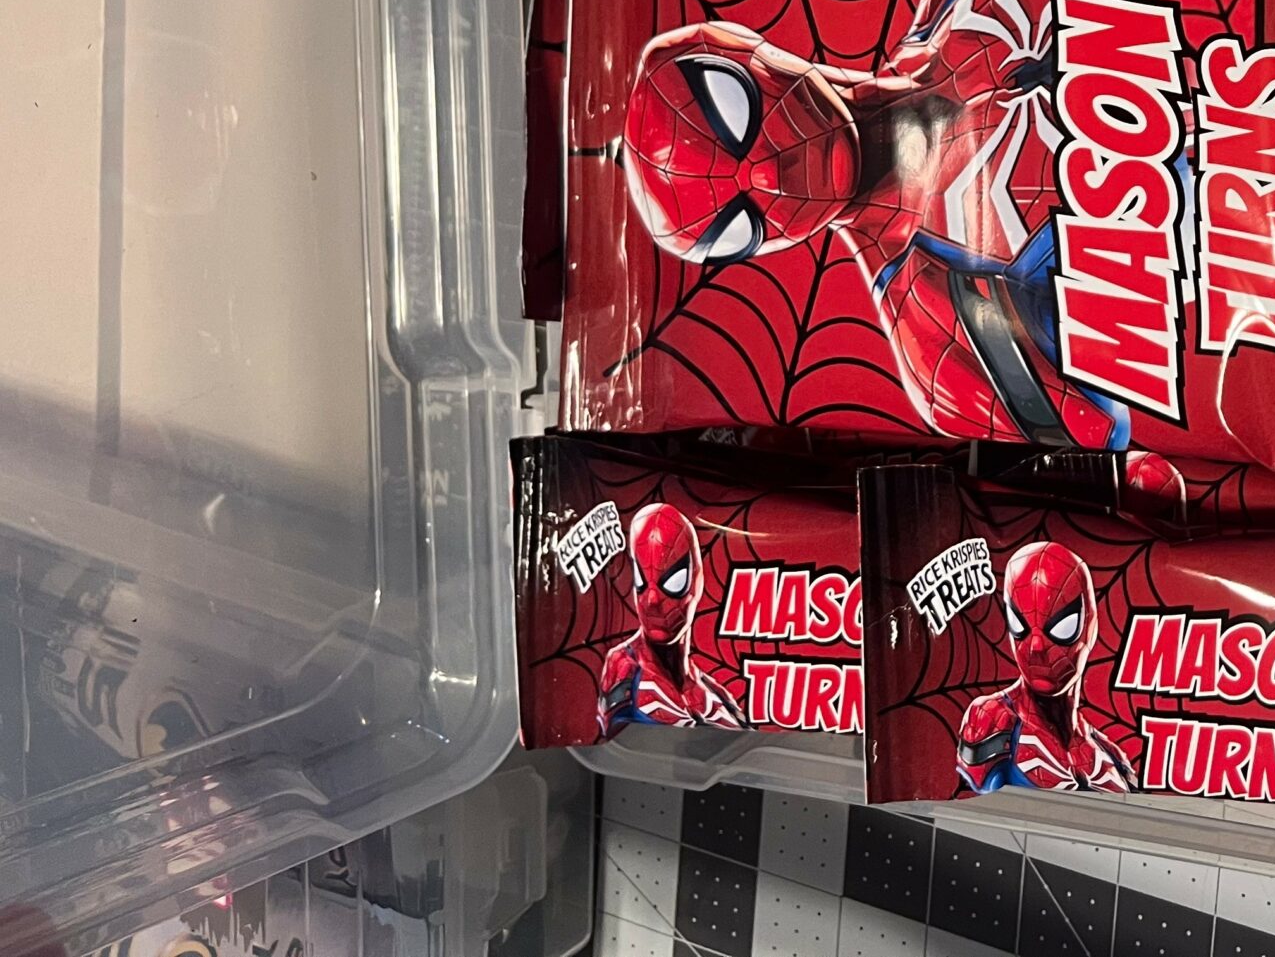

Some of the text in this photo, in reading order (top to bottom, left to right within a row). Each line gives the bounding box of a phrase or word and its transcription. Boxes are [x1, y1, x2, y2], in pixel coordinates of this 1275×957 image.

[565, 524, 625, 592] TREATS
[911, 541, 989, 599] RICE KRISPIES
[918, 562, 995, 632] TREATS
